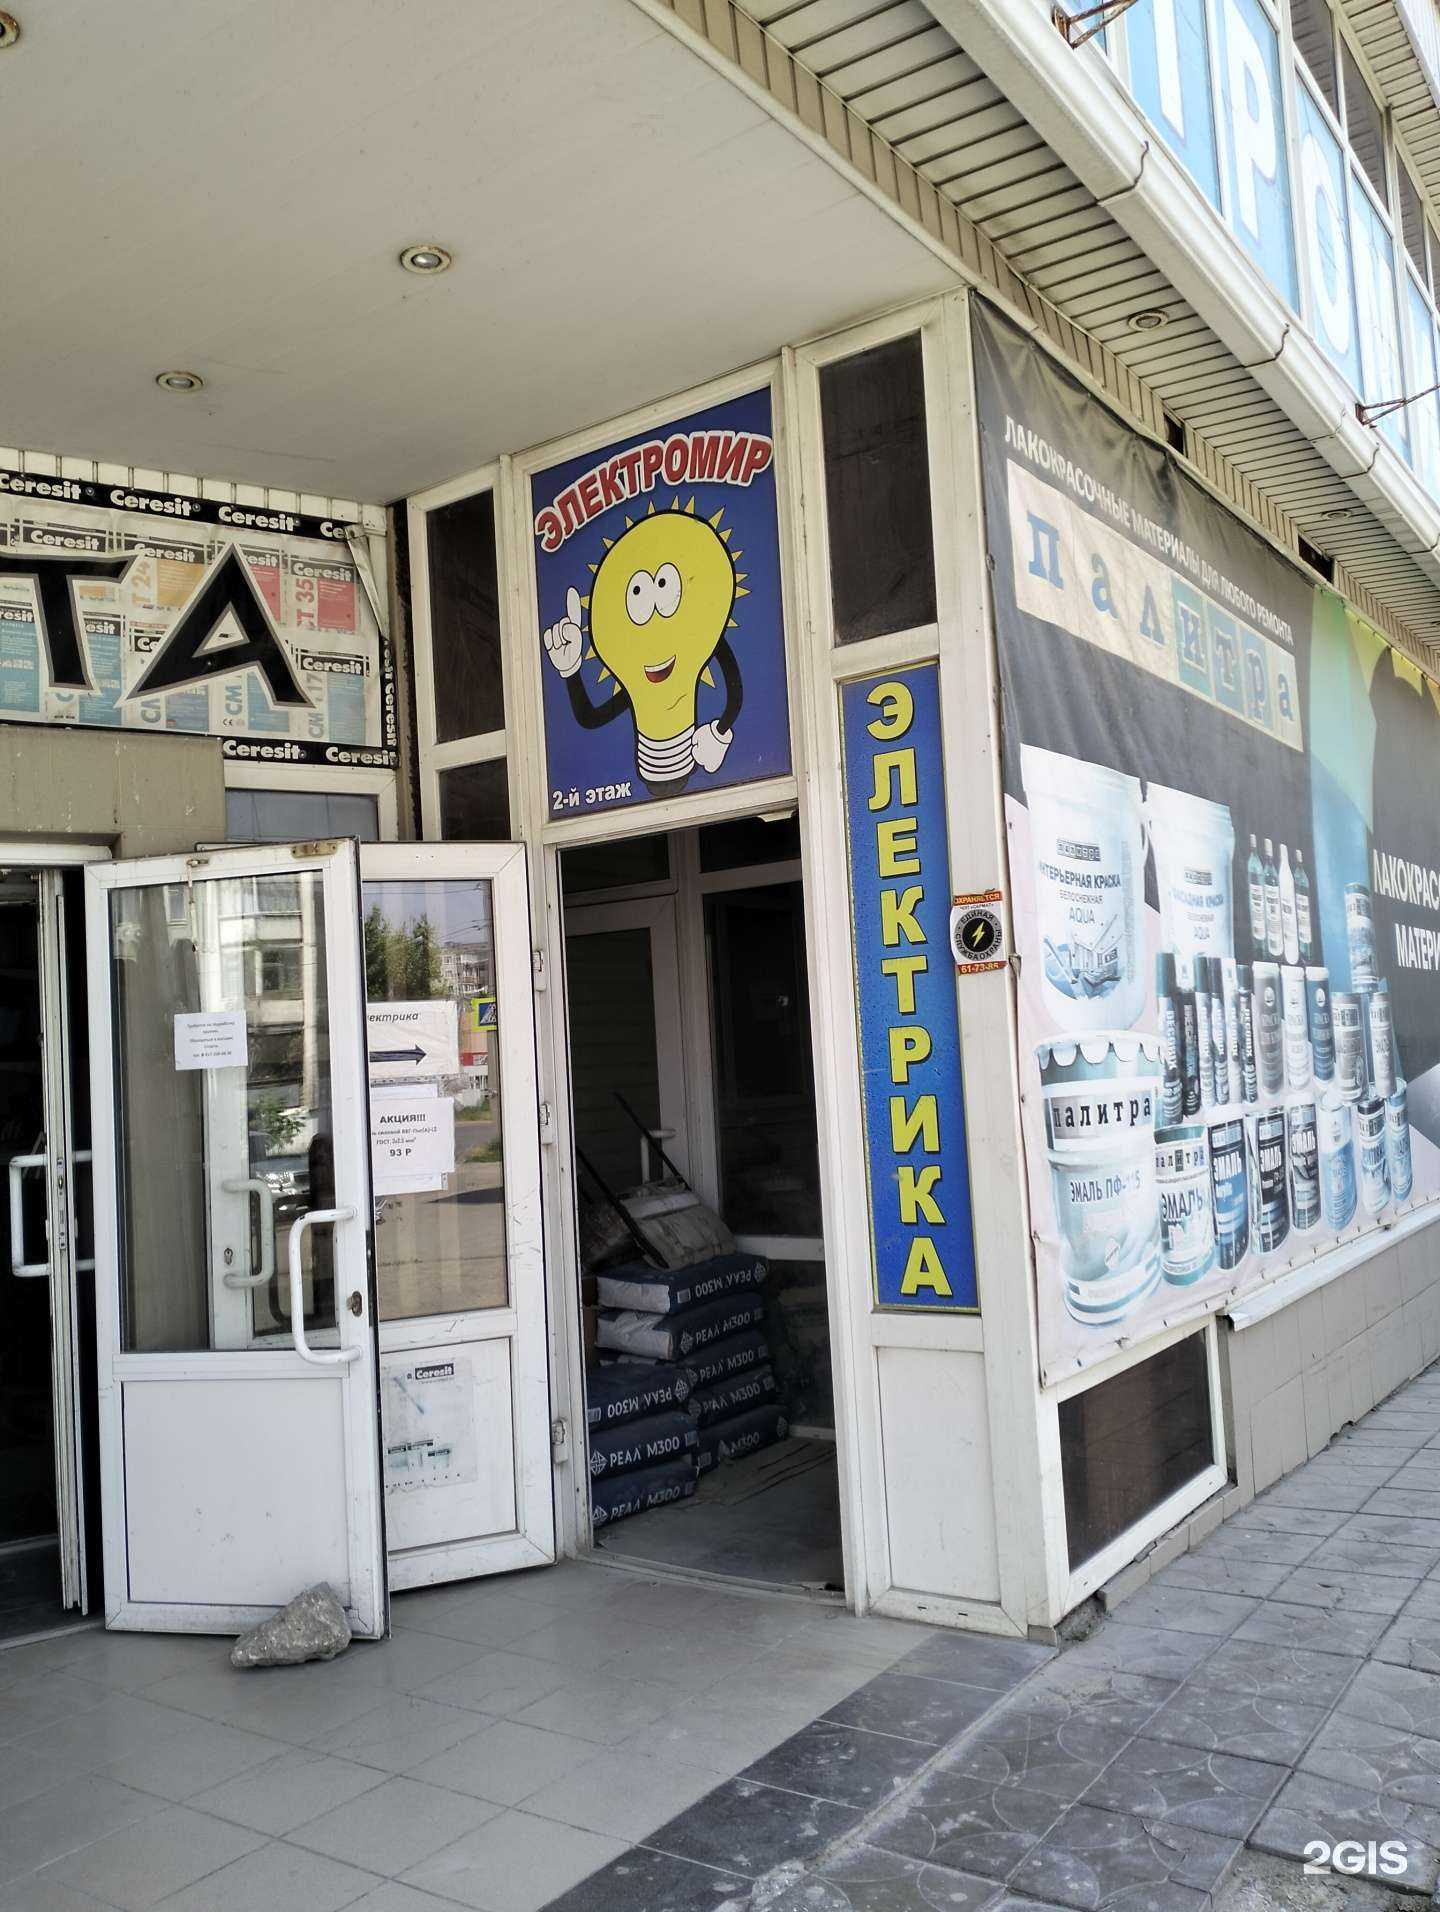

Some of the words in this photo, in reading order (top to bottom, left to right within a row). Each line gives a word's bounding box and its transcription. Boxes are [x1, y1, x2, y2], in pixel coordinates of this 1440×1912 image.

[1005, 414, 1131, 527] ЛАКОКРАСОЧНЫЕ
[0, 472, 82, 501] Ceresit
[534, 430, 774, 553] ЭЛЕКТРОМИР
[110, 488, 193, 518] Ceresit
[218, 505, 296, 533] Ceresit
[30, 529, 100, 551] Ceresit
[247, 553, 278, 568] esit
[292, 562, 352, 583] Ceresit
[86, 620, 116, 636] esit
[302, 657, 362, 675] Ceresit
[384, 682, 398, 747] Ceresit
[222, 739, 301, 761] Ceresit
[325, 745, 397, 766] Ceresit
[551, 786, 581, 811] 2-й
[585, 778, 633, 806] этаж
[1373, 849, 1440, 911] ЛАКОКРАС
[960, 909, 995, 925] ЕДИНАЯ
[865, 680, 954, 1297] ЭЛЕКТРИКА
[367, 1012, 419, 1025] ектрика
[379, 1113, 426, 1125] АКЦИЯ!!!
[389, 1148, 402, 1157] 93
[1070, 1178, 1103, 1203] ЭМАЛЬ
[1160, 1185, 1204, 1221] ЭМАЛЬ
[609, 1446, 642, 1469] РЕАЛ
[647, 1435, 680, 1458] М300
